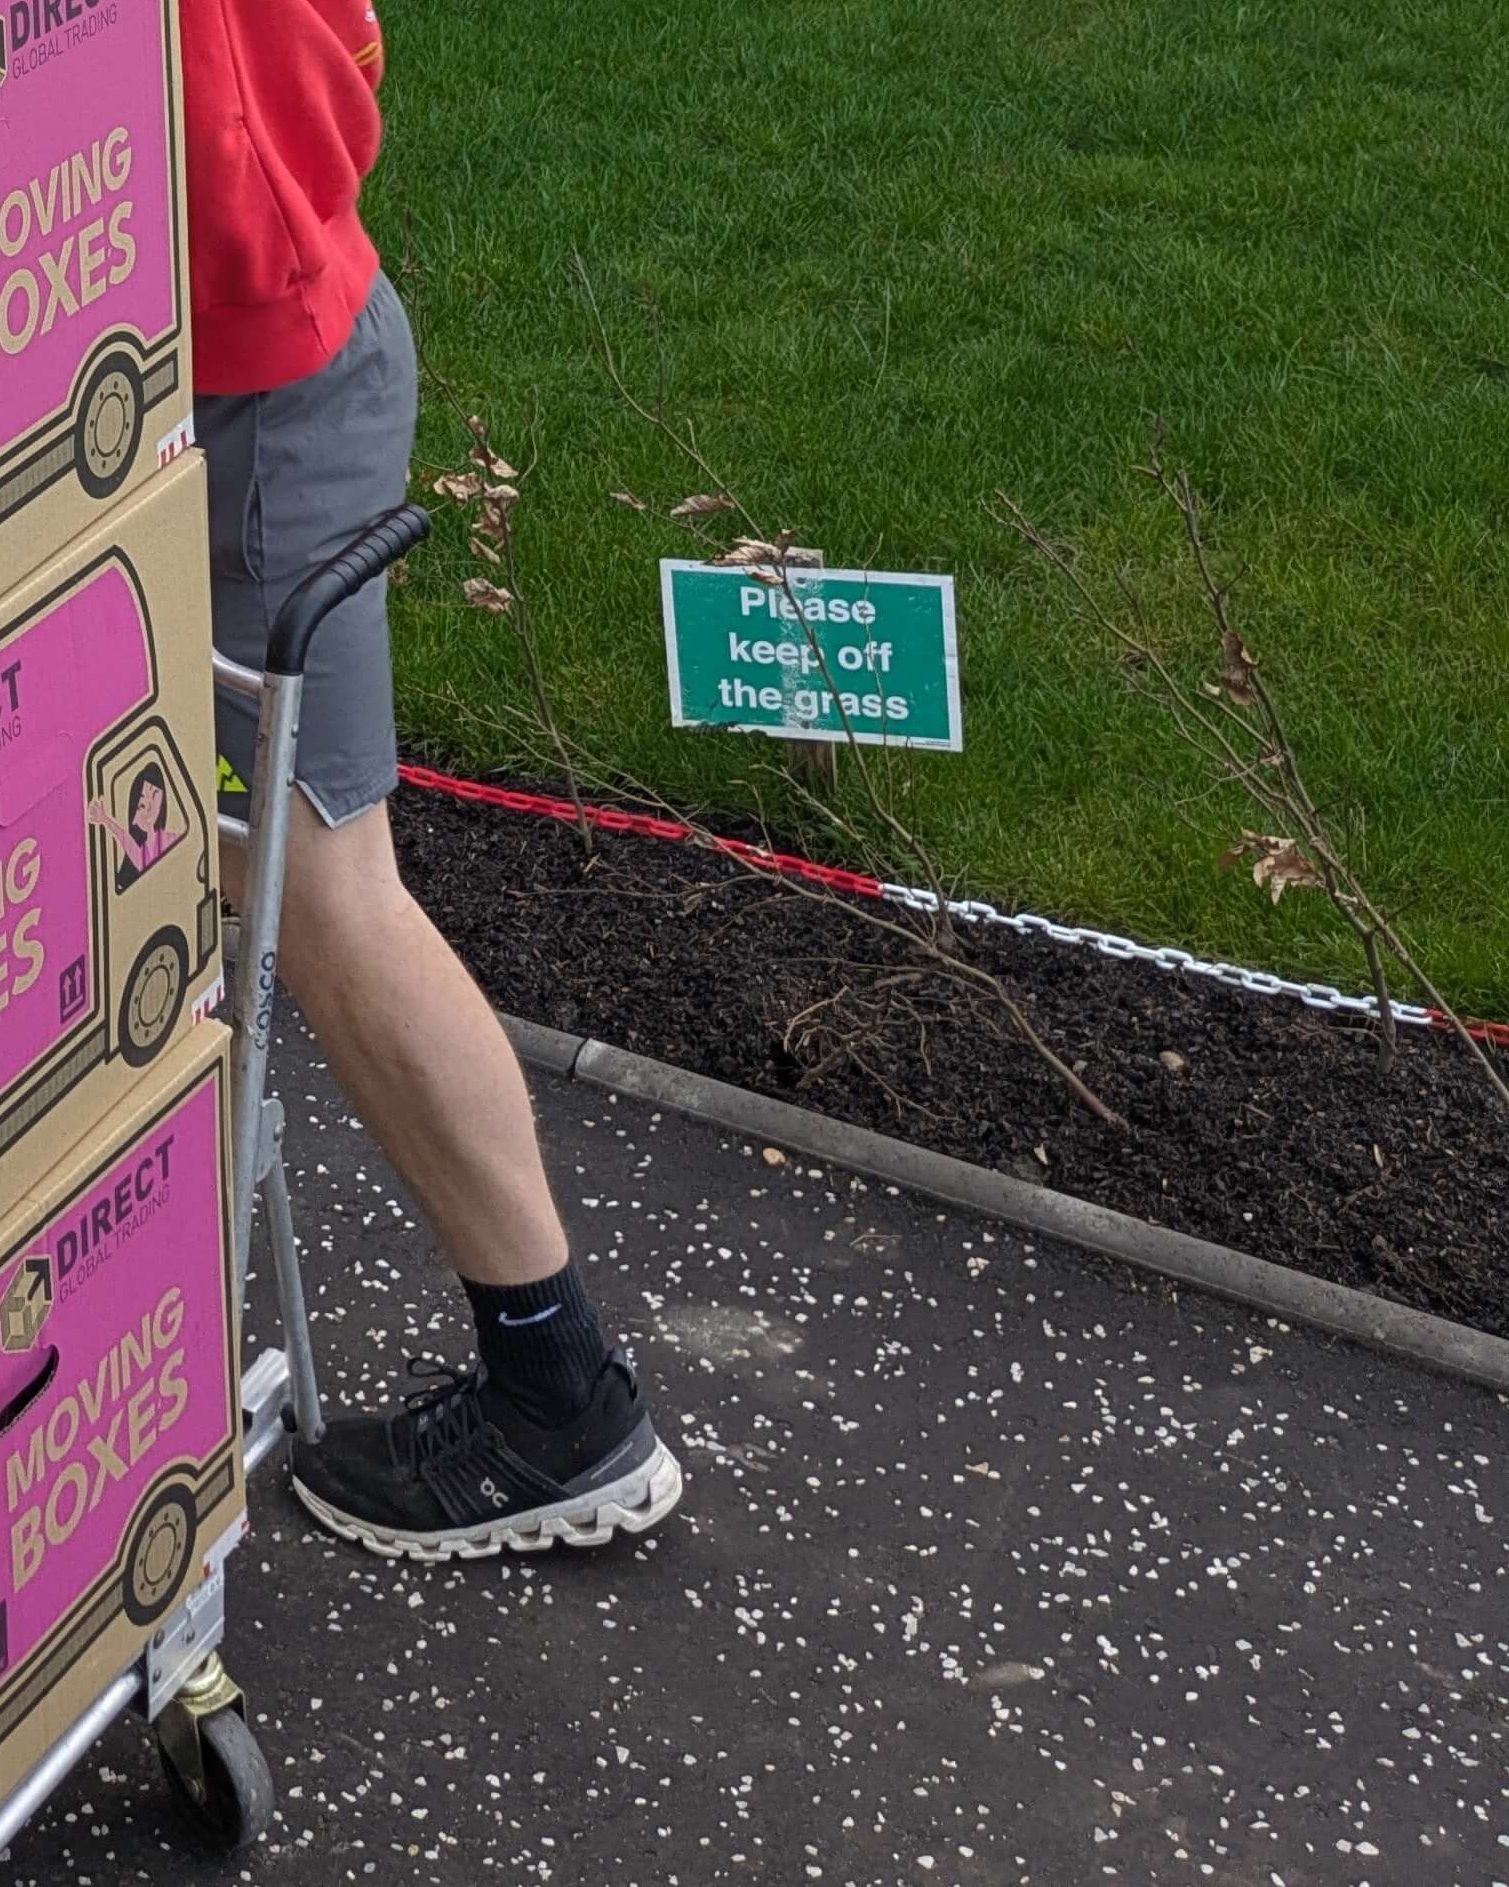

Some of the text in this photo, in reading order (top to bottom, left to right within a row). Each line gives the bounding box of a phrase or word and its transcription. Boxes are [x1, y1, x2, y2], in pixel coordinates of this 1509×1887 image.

[12, 4, 117, 80] GLOBAL TRADING
[729, 631, 892, 674] keep off
[740, 586, 876, 625] Please
[718, 678, 909, 720] the grass
[57, 1134, 174, 1280] DIRECT
[59, 1184, 171, 1304] GLOBAL TRADING
[7, 1287, 184, 1512] MOVING
[11, 1348, 188, 1593] BOXES
